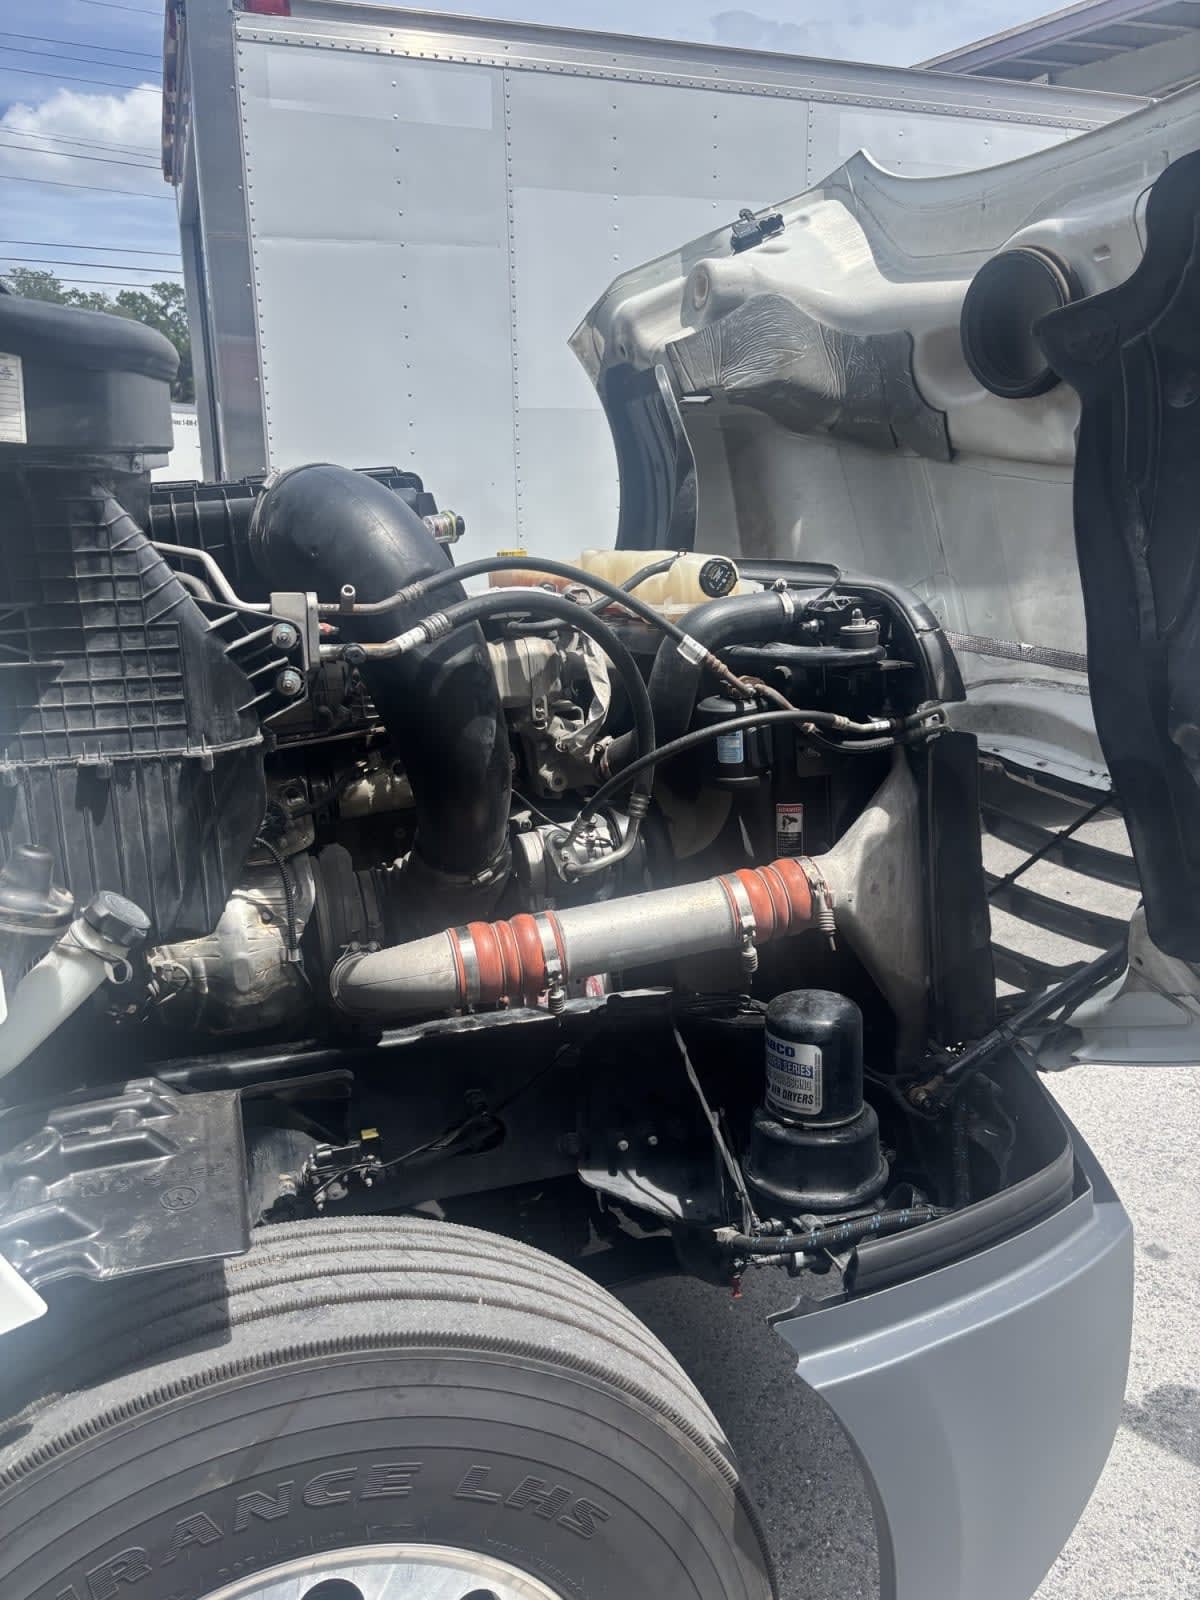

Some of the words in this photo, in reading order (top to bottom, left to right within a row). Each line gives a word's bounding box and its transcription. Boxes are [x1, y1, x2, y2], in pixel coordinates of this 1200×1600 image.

[782, 1089, 813, 1104] DRYERS
[55, 1461, 425, 1600] RANCE
[455, 1463, 611, 1540] LHS
